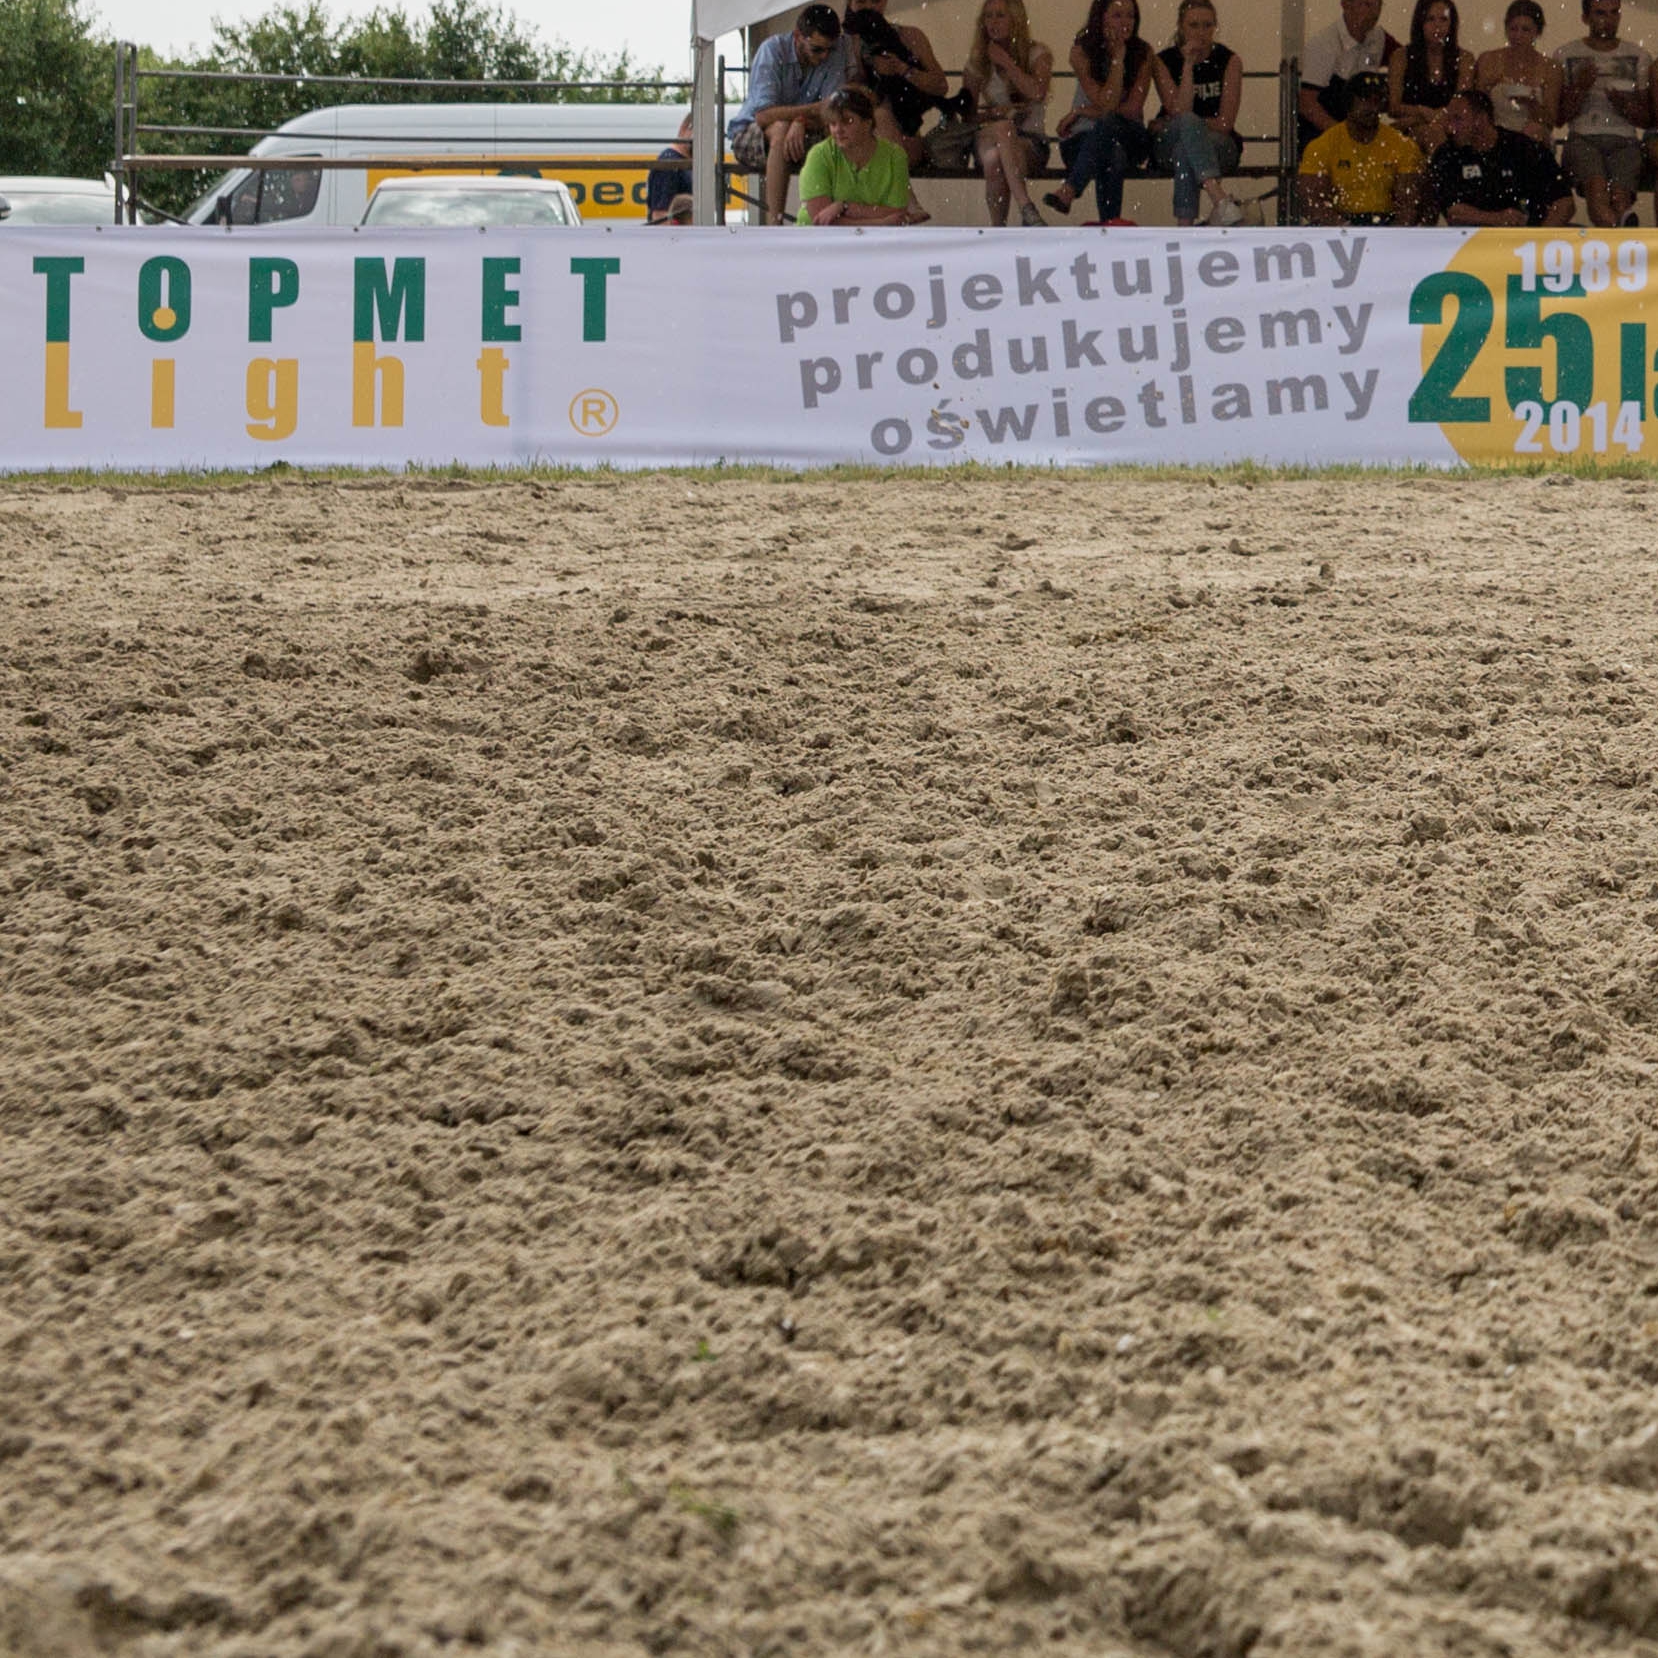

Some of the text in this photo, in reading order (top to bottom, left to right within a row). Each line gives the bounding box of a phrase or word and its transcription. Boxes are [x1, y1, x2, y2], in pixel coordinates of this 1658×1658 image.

[33, 256, 621, 342] TOPMET
[776, 237, 1368, 342] projektujemy
[1514, 240, 1648, 292] 1989
[44, 342, 511, 440] Light
[800, 303, 1374, 409] produkujemy
[1408, 271, 1594, 425] 25
[870, 369, 1380, 455] oświetlamy
[1514, 401, 1644, 453] 2014
